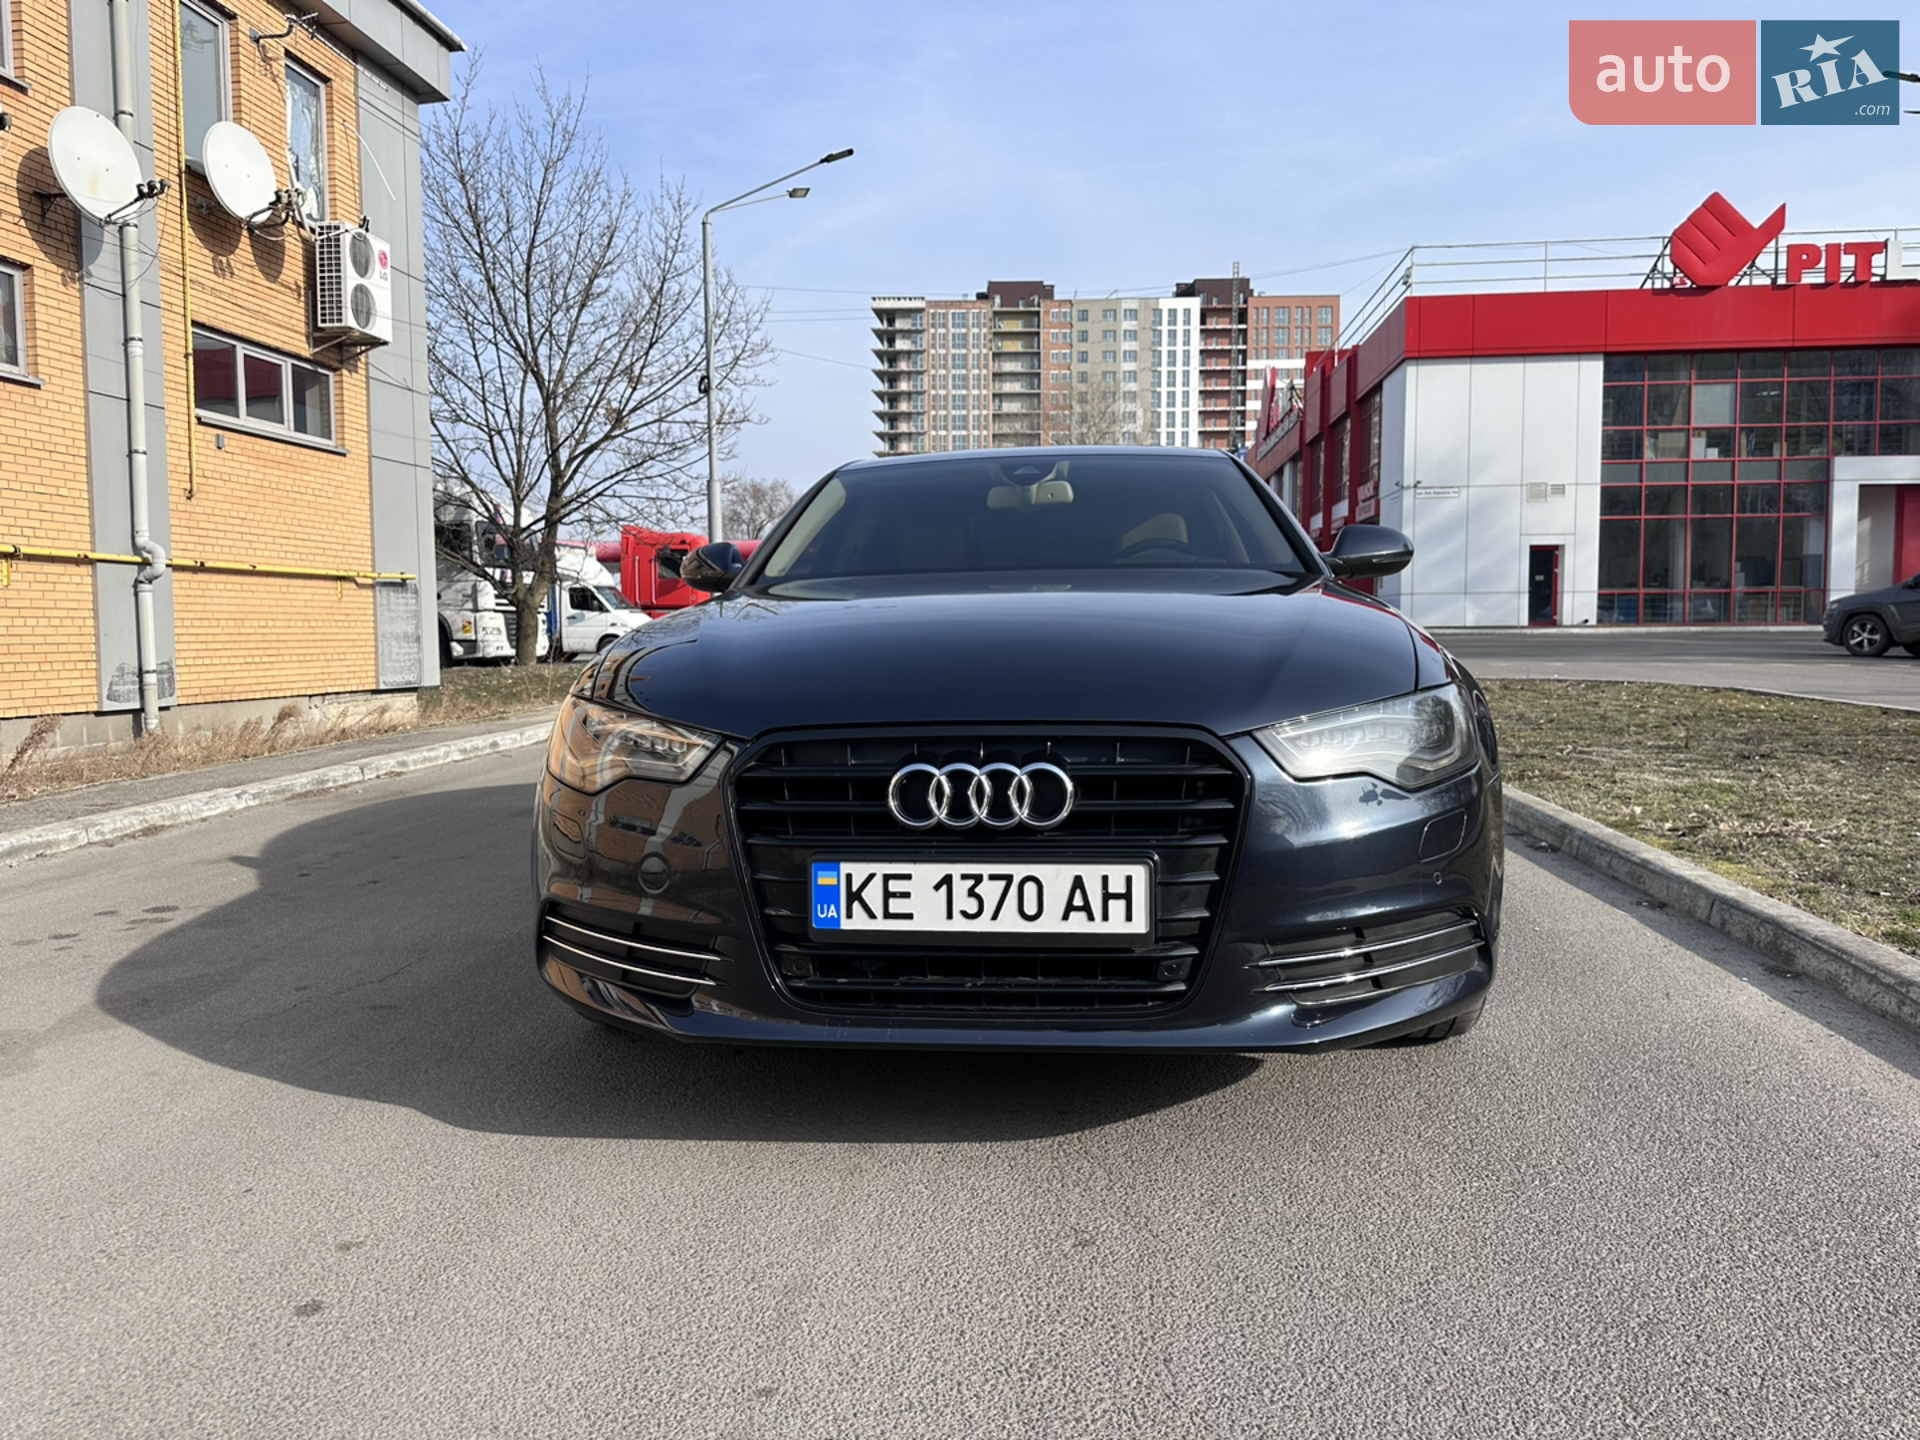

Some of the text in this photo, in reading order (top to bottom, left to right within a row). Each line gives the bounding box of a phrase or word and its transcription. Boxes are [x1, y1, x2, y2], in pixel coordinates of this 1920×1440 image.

[817, 903, 838, 919] UA
[845, 871, 1134, 922] KE 1370 AH
